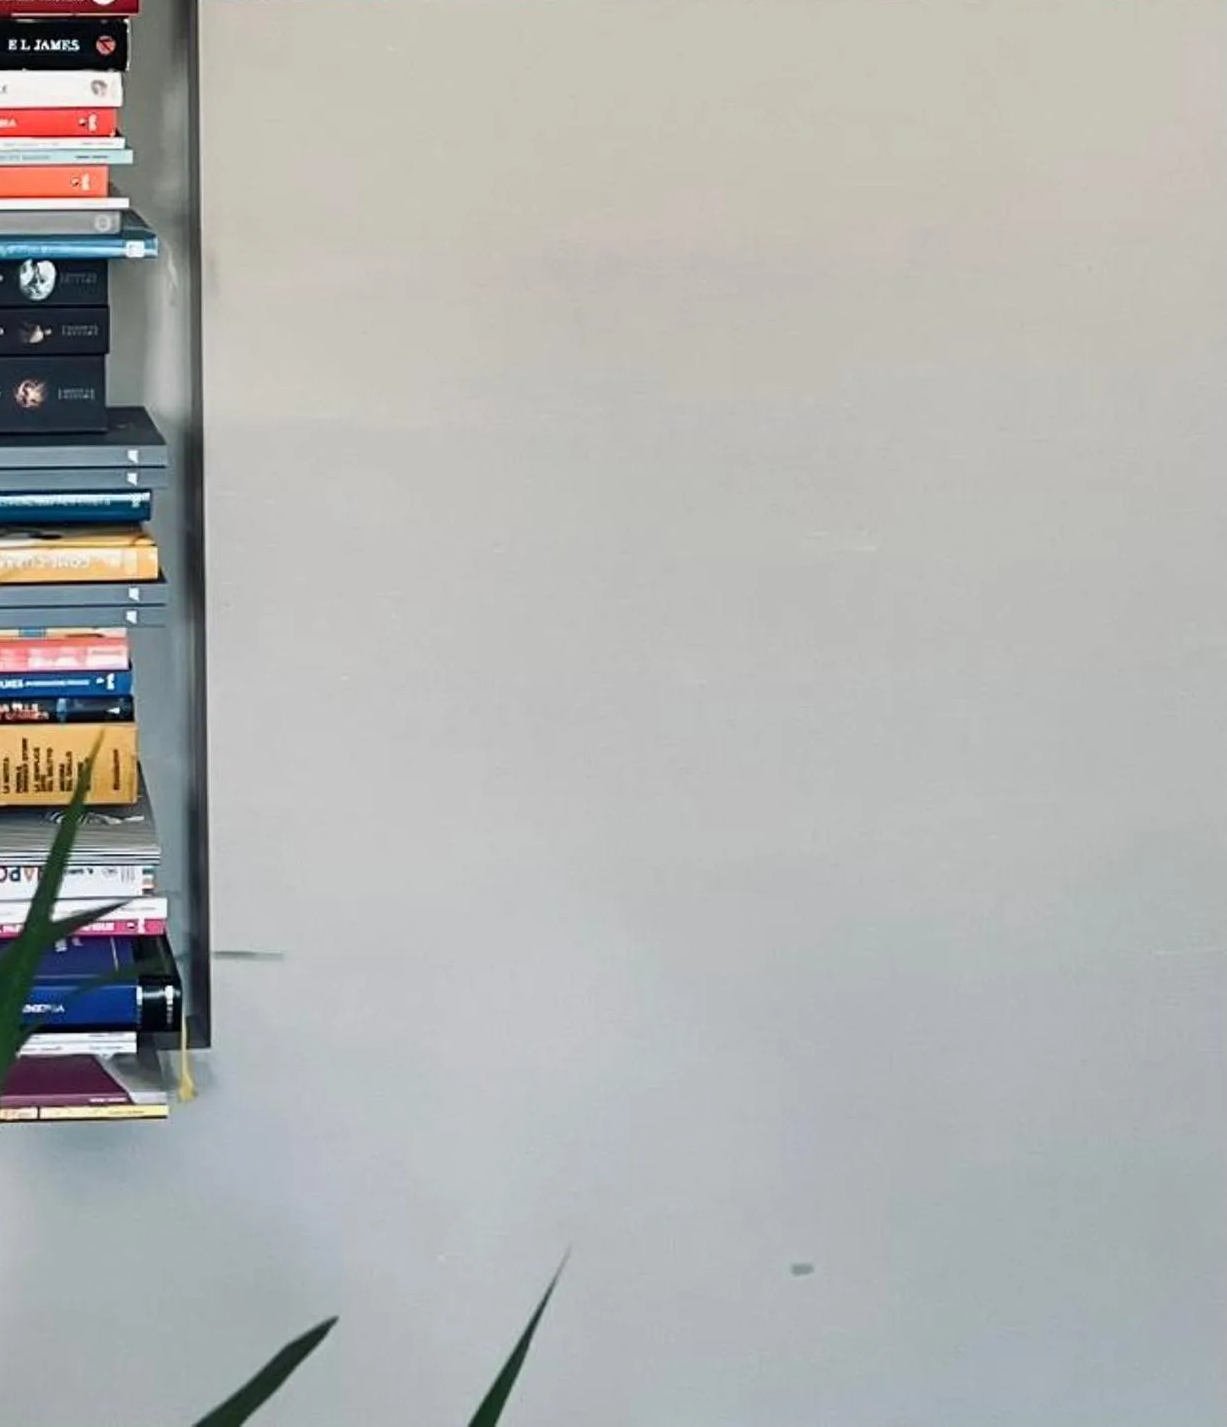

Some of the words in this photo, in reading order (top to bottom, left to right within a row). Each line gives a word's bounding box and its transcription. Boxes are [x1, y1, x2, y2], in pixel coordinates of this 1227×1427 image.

[8, 39, 17, 51] E
[21, 39, 30, 50] L
[33, 39, 81, 51] JAMES
